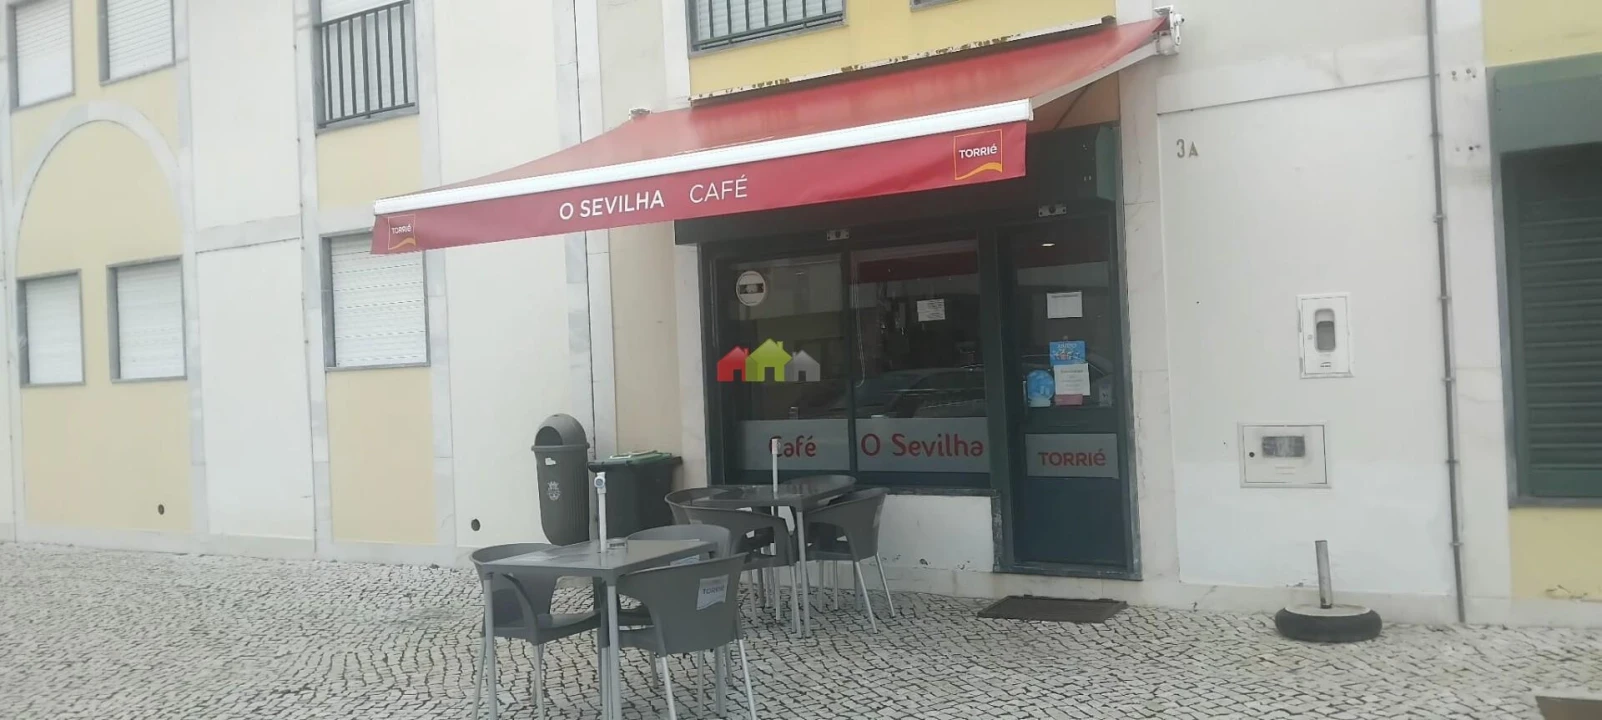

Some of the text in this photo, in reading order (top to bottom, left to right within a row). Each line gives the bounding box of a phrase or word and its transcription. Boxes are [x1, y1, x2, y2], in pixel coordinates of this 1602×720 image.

[559, 174, 748, 221] O SEVILHA CAFÉ
[768, 433, 984, 457] Café O Sevilha
